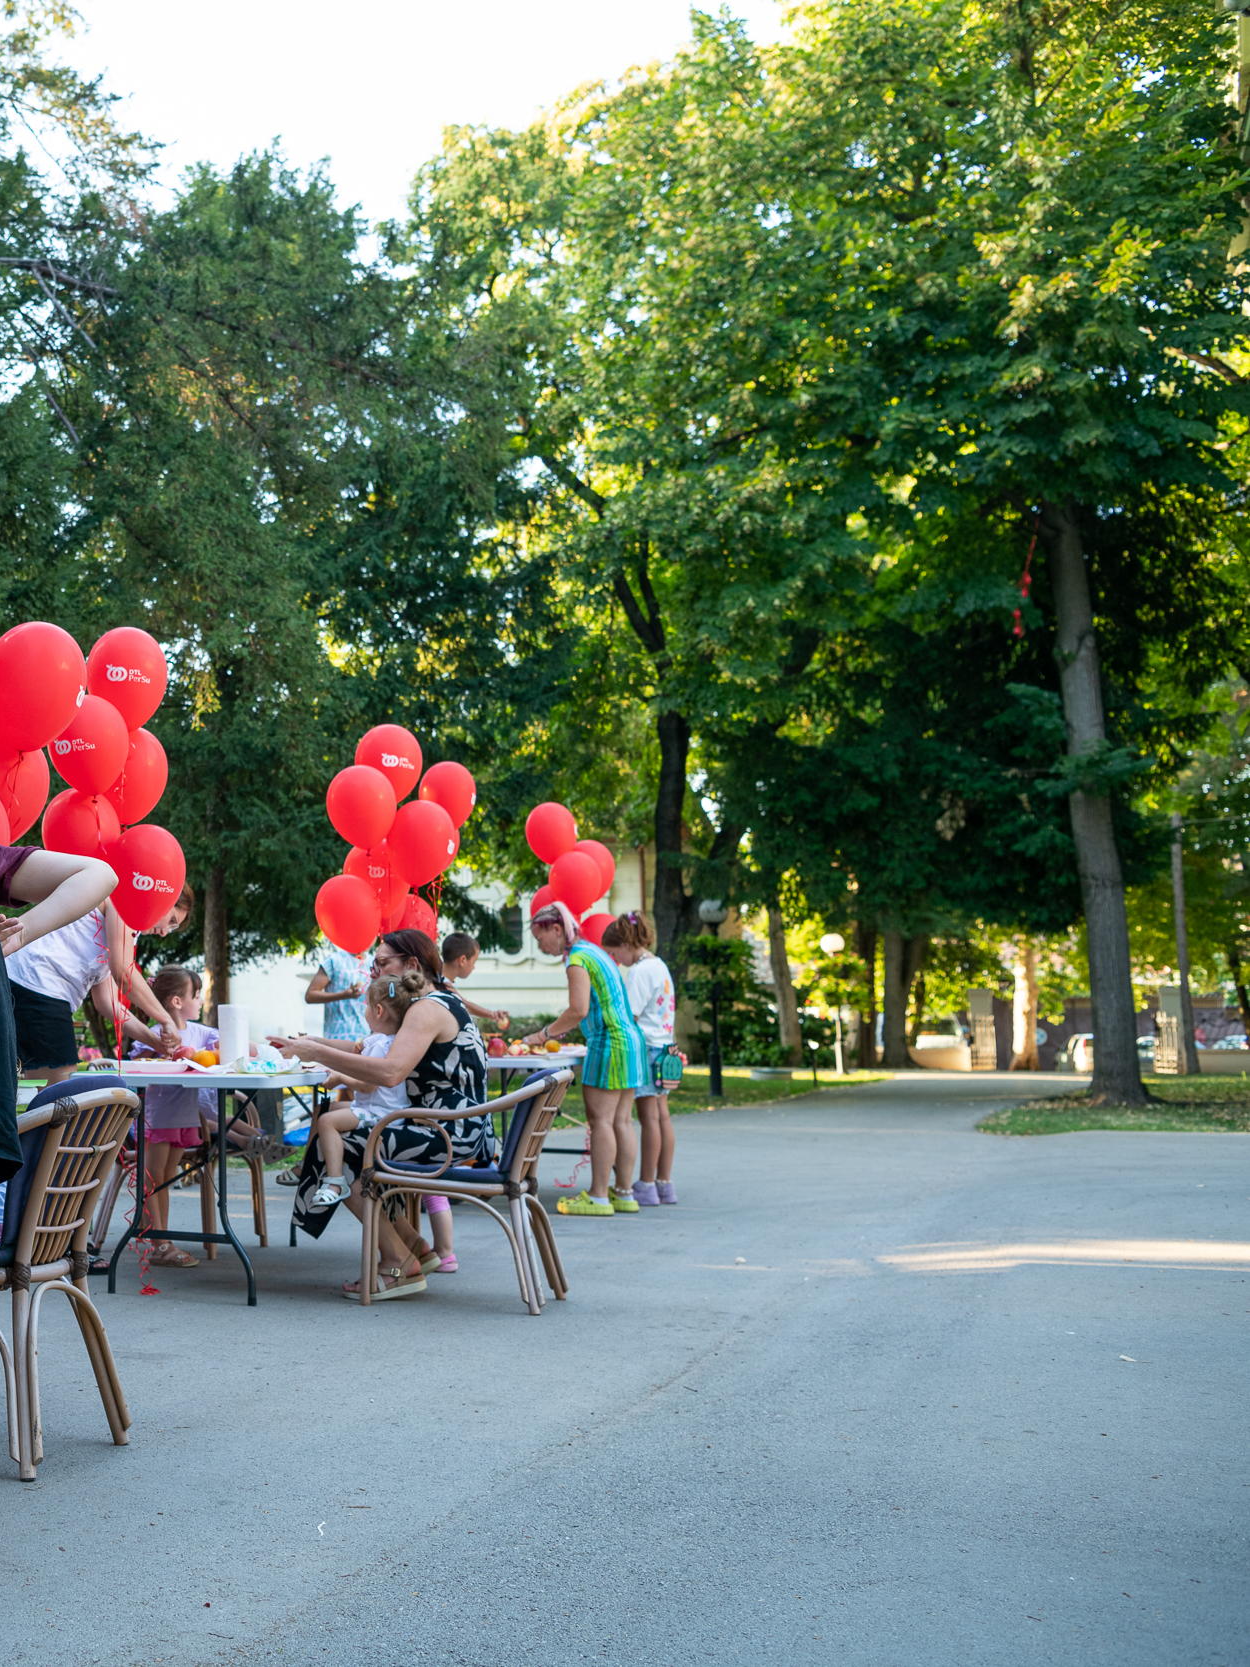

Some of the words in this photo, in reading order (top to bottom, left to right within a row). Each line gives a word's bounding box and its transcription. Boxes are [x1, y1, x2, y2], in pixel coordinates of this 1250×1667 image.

[129, 675, 150, 684] PerSu
[73, 743, 95, 751] PerSu
[155, 885, 174, 893] PerSu
